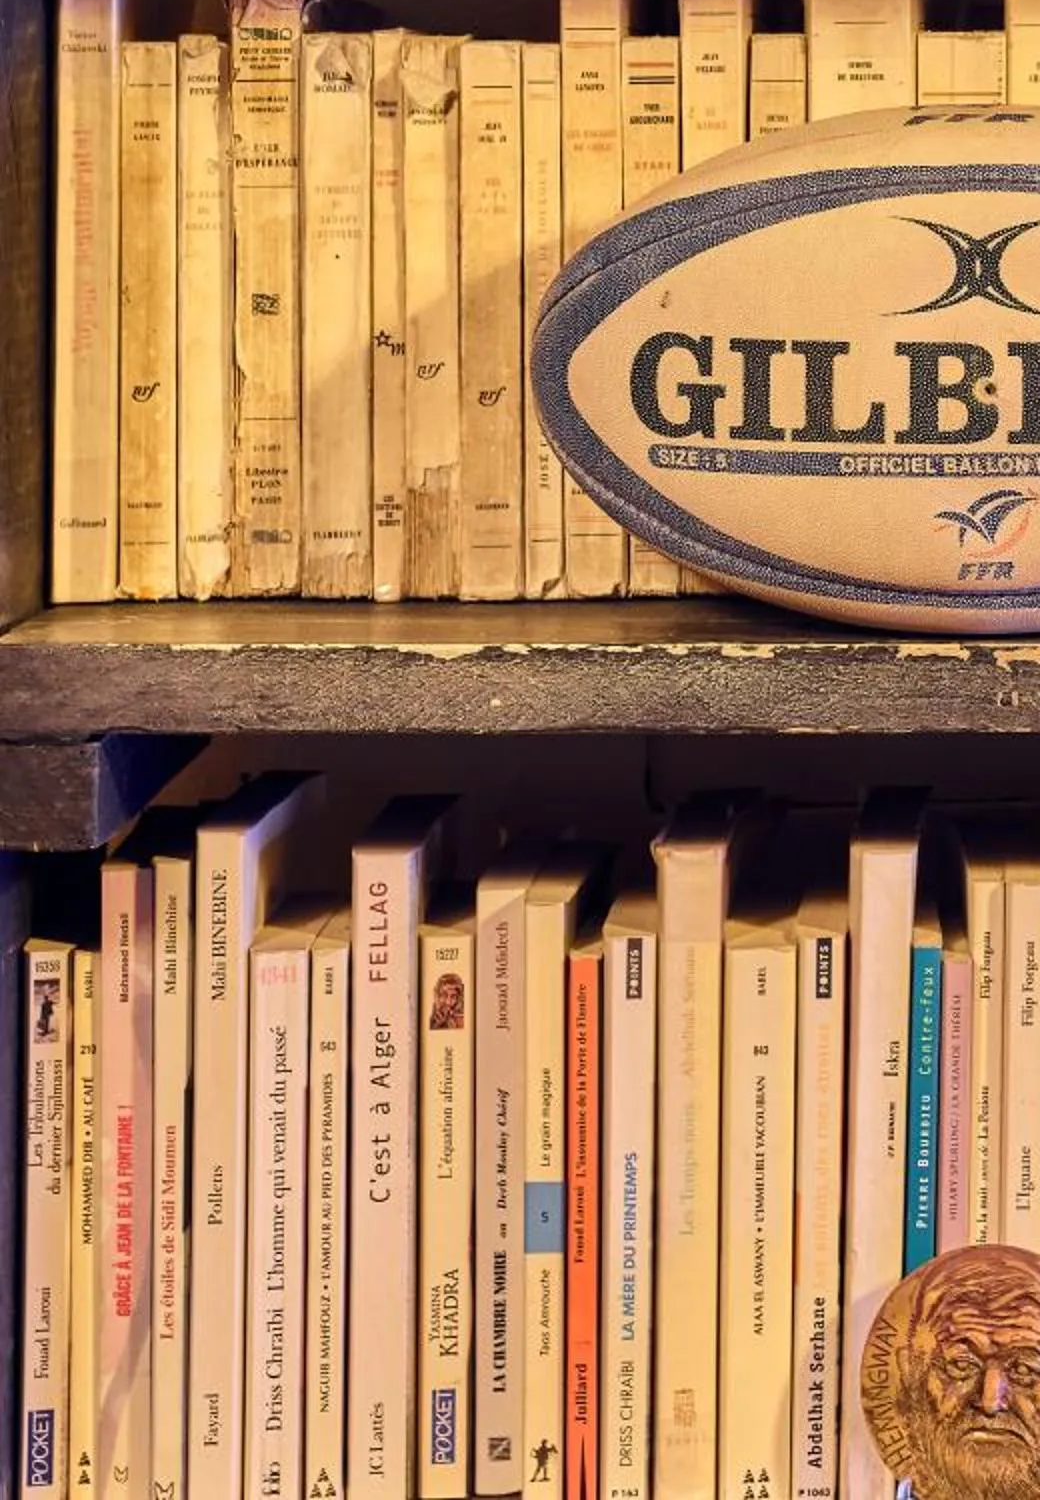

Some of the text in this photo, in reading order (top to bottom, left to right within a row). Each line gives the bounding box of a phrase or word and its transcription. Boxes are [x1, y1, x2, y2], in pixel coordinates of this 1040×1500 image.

[658, 449, 704, 466] SIZE
[840, 457, 936, 473] OFFICIEL
[943, 457, 1029, 475] BALLON
[959, 562, 1014, 580] FFR
[212, 869, 228, 1001] Mahi BINEBINE
[817, 945, 830, 994] POINTS
[368, 882, 398, 1203] C'est à Alger FELLAG
[918, 967, 934, 1074] Contre-feux
[116, 1115, 133, 1177] FONTAINE
[116, 1181, 132, 1196] LA
[116, 1201, 132, 1218] DE
[1016, 1146, 1032, 1211] L'Iguane
[116, 1223, 133, 1256] JEAN
[265, 1027, 292, 1431] Driss Chraïbi L'homme qui venait du passé
[115, 1260, 132, 1270] À
[115, 1275, 133, 1317] GRÂCE
[35, 1286, 52, 1379] Fouad Laroui
[429, 1285, 441, 1341] YASMINA
[441, 1268, 459, 1357] KHADRA
[618, 1153, 638, 1467] DRISS CHRAÏBI LA MÈRE DU PRINTEMPS
[573, 1363, 588, 1426] Julliard
[806, 1297, 826, 1468] Abdelhak Serhane
[864, 1317, 913, 1468] HEMINGWAY
[30, 1410, 53, 1485] POCKET
[434, 1389, 454, 1464] POCKET
